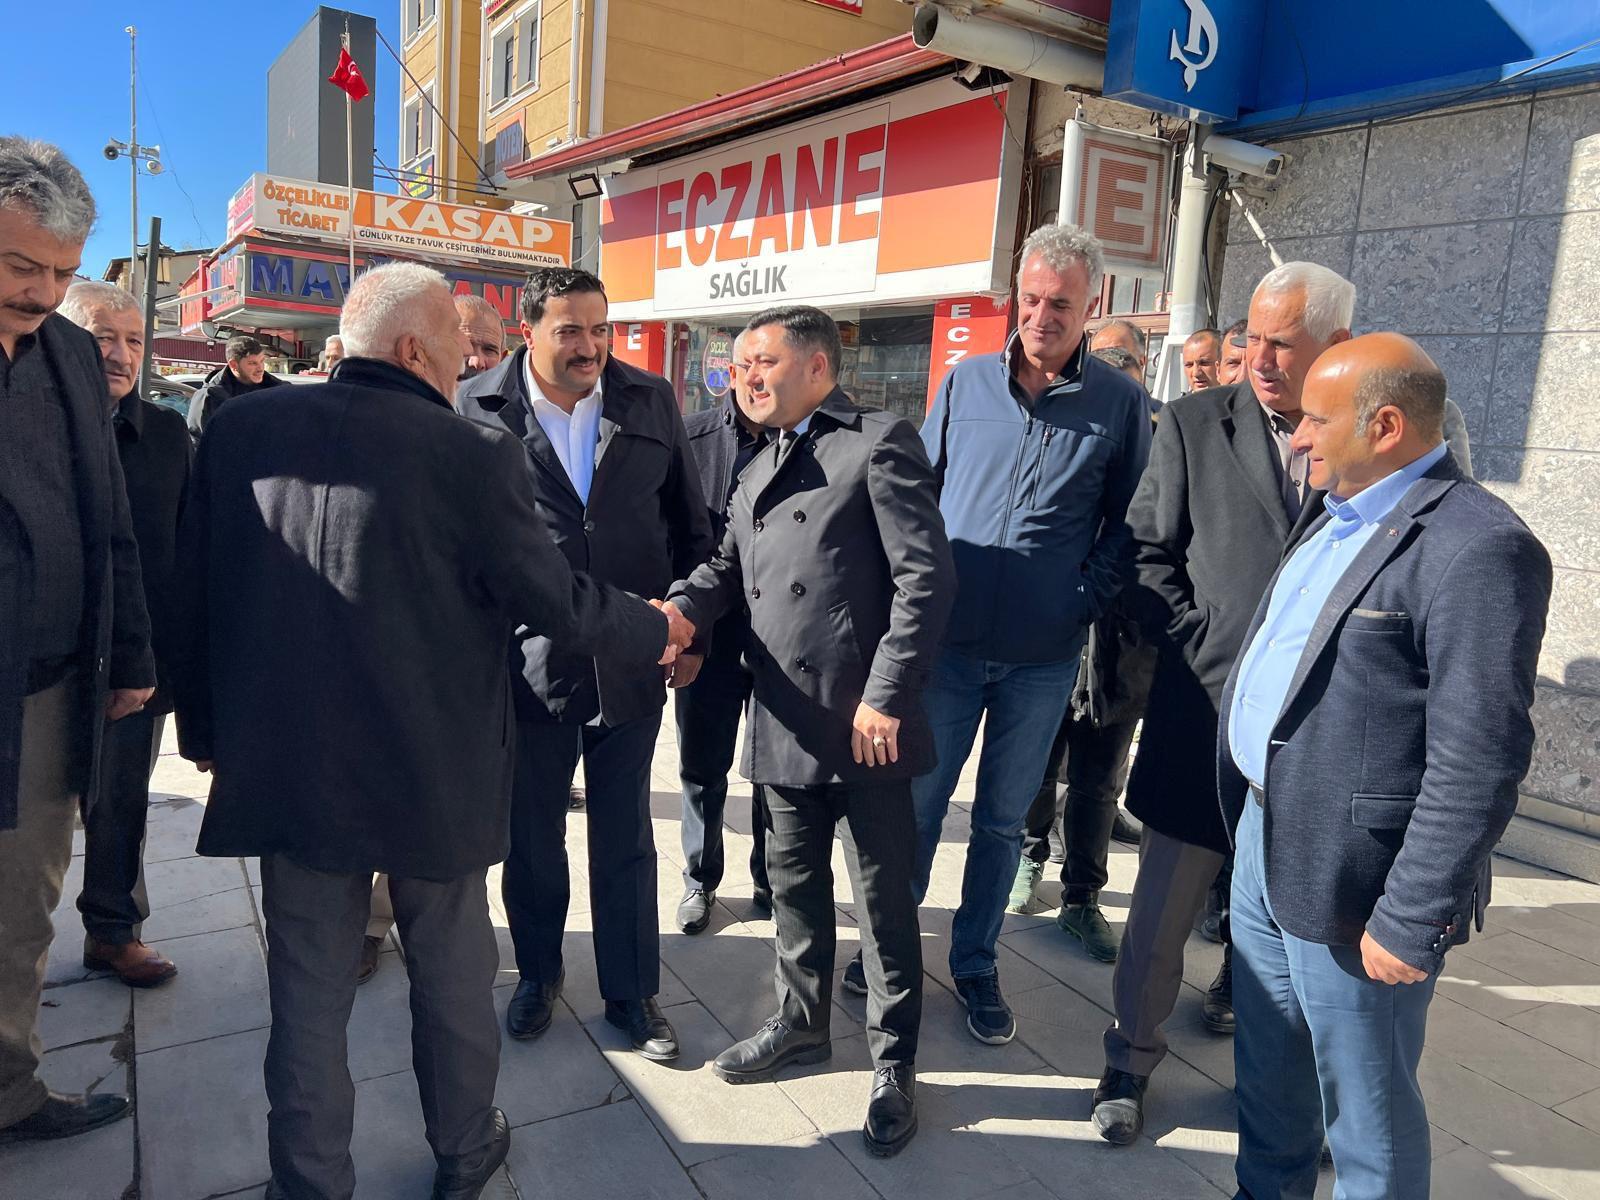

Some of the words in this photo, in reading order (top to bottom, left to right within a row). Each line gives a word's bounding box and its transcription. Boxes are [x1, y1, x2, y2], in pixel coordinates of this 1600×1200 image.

[657, 124, 887, 271] ECZANE
[1095, 157, 1148, 246] E
[277, 208, 340, 233] TİCARET
[374, 195, 554, 249] KASAP
[359, 229, 393, 241] GÜNLÜK
[394, 235, 415, 245] TAZE
[416, 239, 444, 249] TAVUK
[445, 242, 496, 256] ÇEŞİTLERİMİZ
[497, 250, 560, 266] BULUNMAKTADIR
[709, 264, 787, 299] SAĞLIK
[627, 323, 642, 350] E
